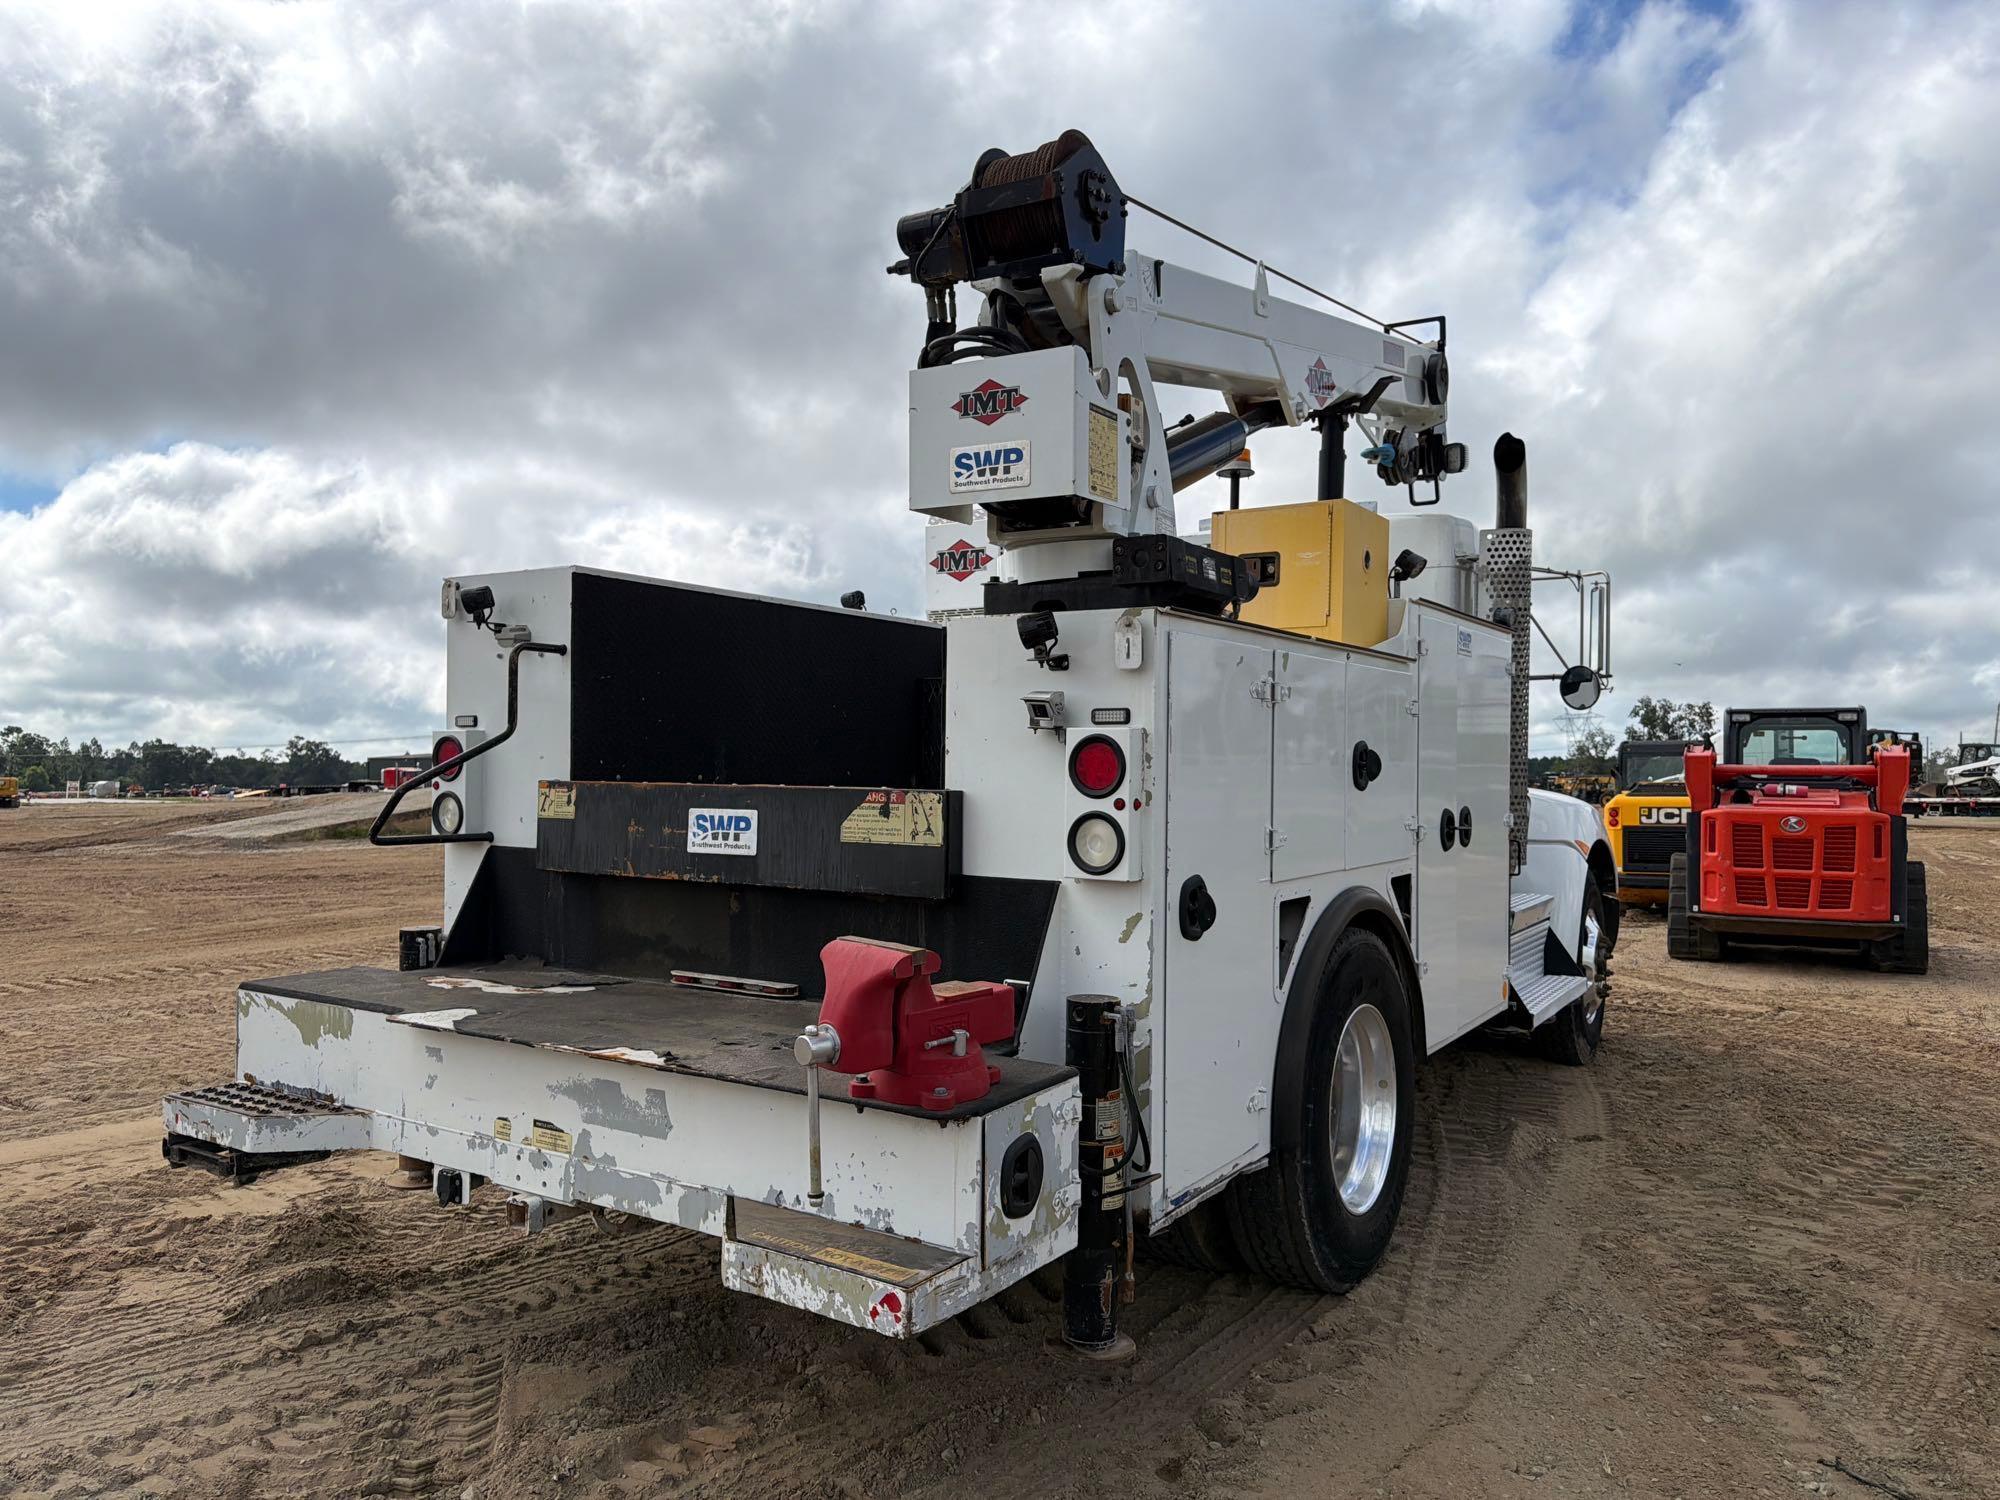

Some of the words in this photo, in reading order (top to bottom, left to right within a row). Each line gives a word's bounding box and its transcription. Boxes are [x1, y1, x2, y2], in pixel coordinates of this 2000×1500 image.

[960, 387, 1019, 418] IMT
[954, 447, 1024, 479] SWP
[954, 480, 990, 488] Southwest
[992, 475, 1024, 484] Products
[937, 548, 986, 573] IMT
[865, 791, 897, 803] ANGR
[692, 814, 752, 842] SWP
